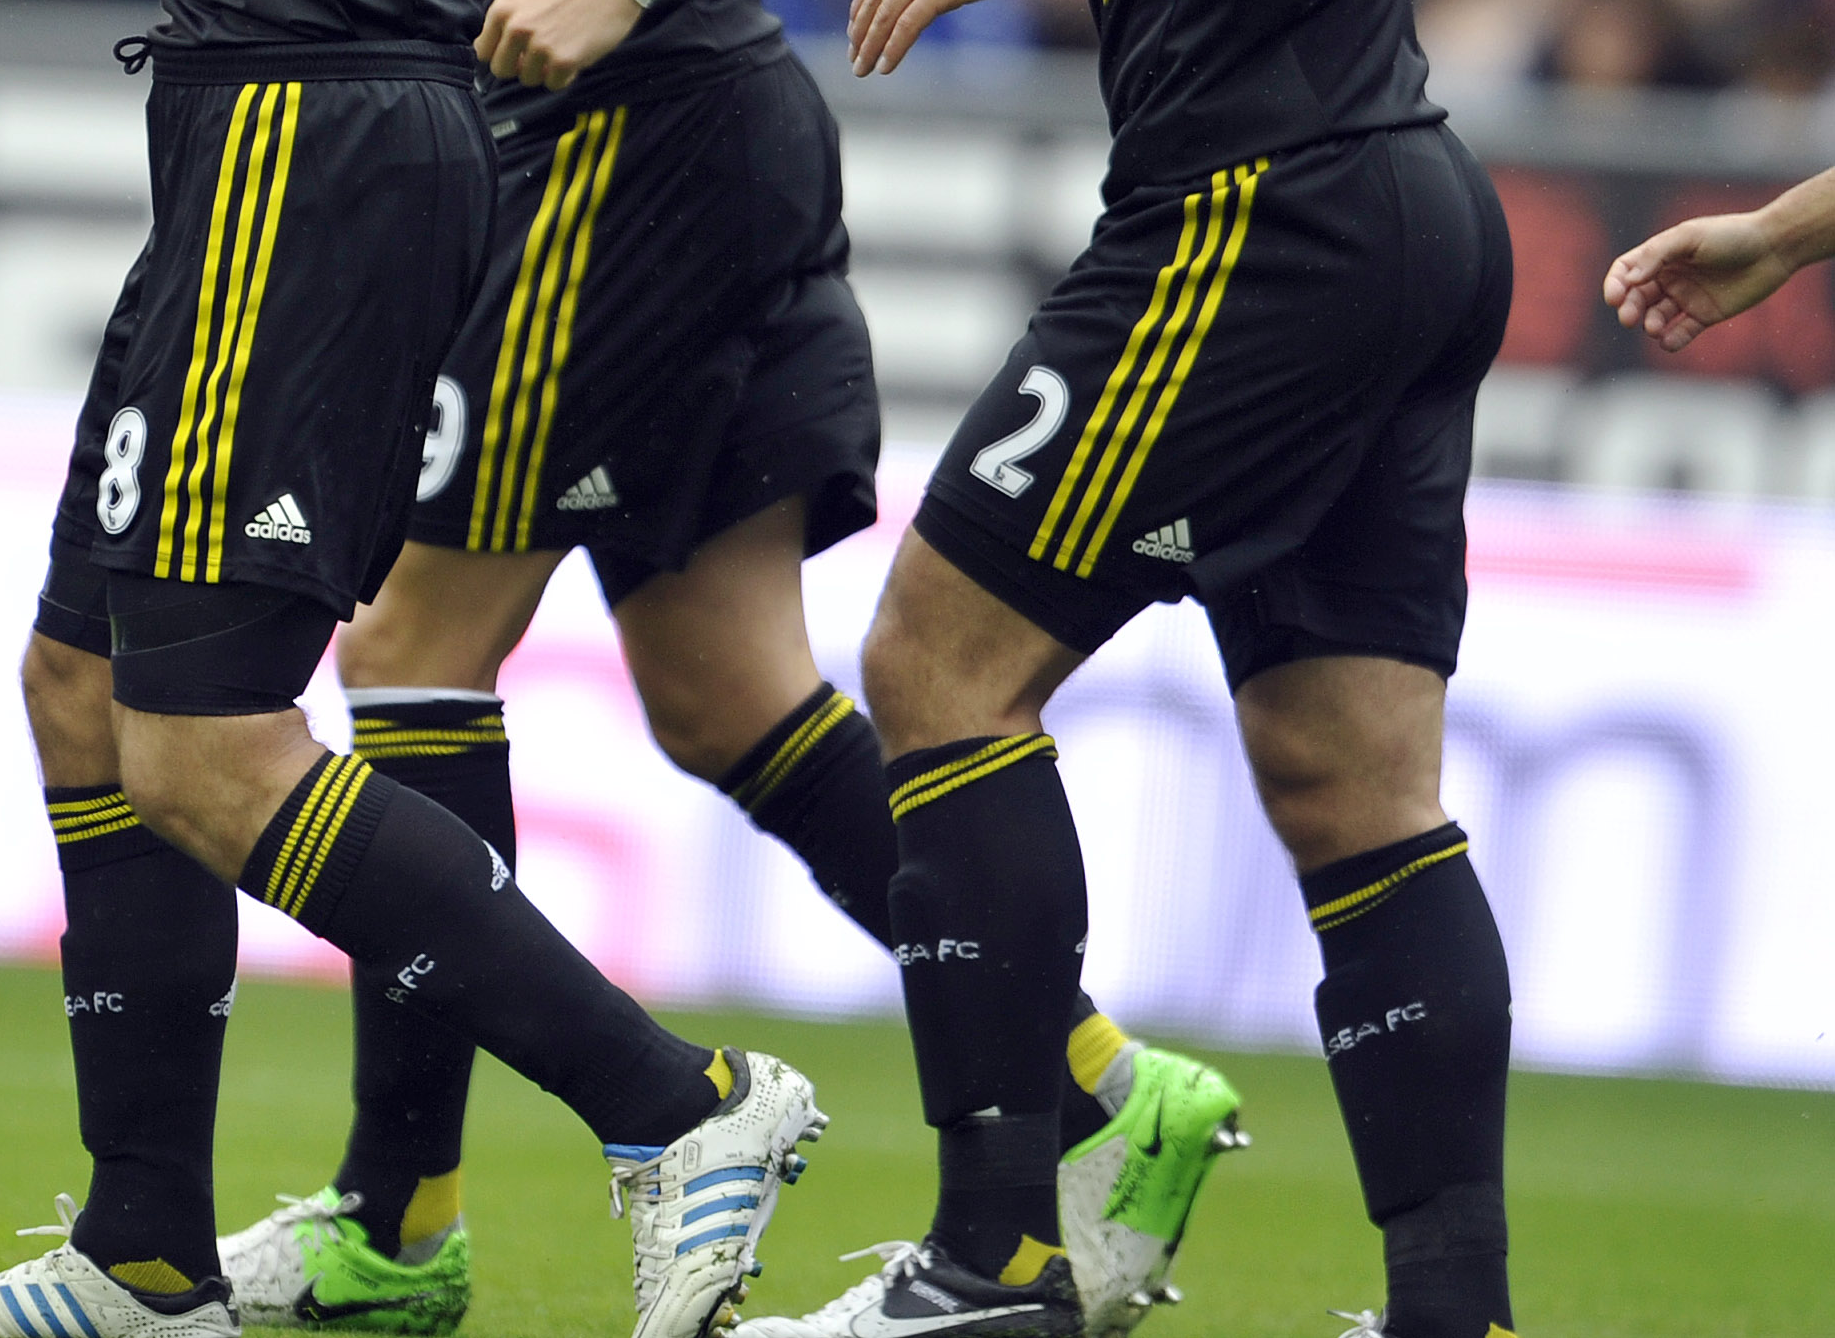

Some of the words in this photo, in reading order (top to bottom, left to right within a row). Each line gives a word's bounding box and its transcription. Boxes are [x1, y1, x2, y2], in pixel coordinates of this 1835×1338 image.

[968, 365, 1070, 500] 2
[97, 406, 148, 536] 8
[556, 491, 619, 511] adidas
[244, 520, 312, 545] adidas
[1132, 537, 1195, 564] adidas
[937, 938, 981, 962] FC
[93, 991, 124, 1014] FC
[1385, 1002, 1428, 1033] FC
